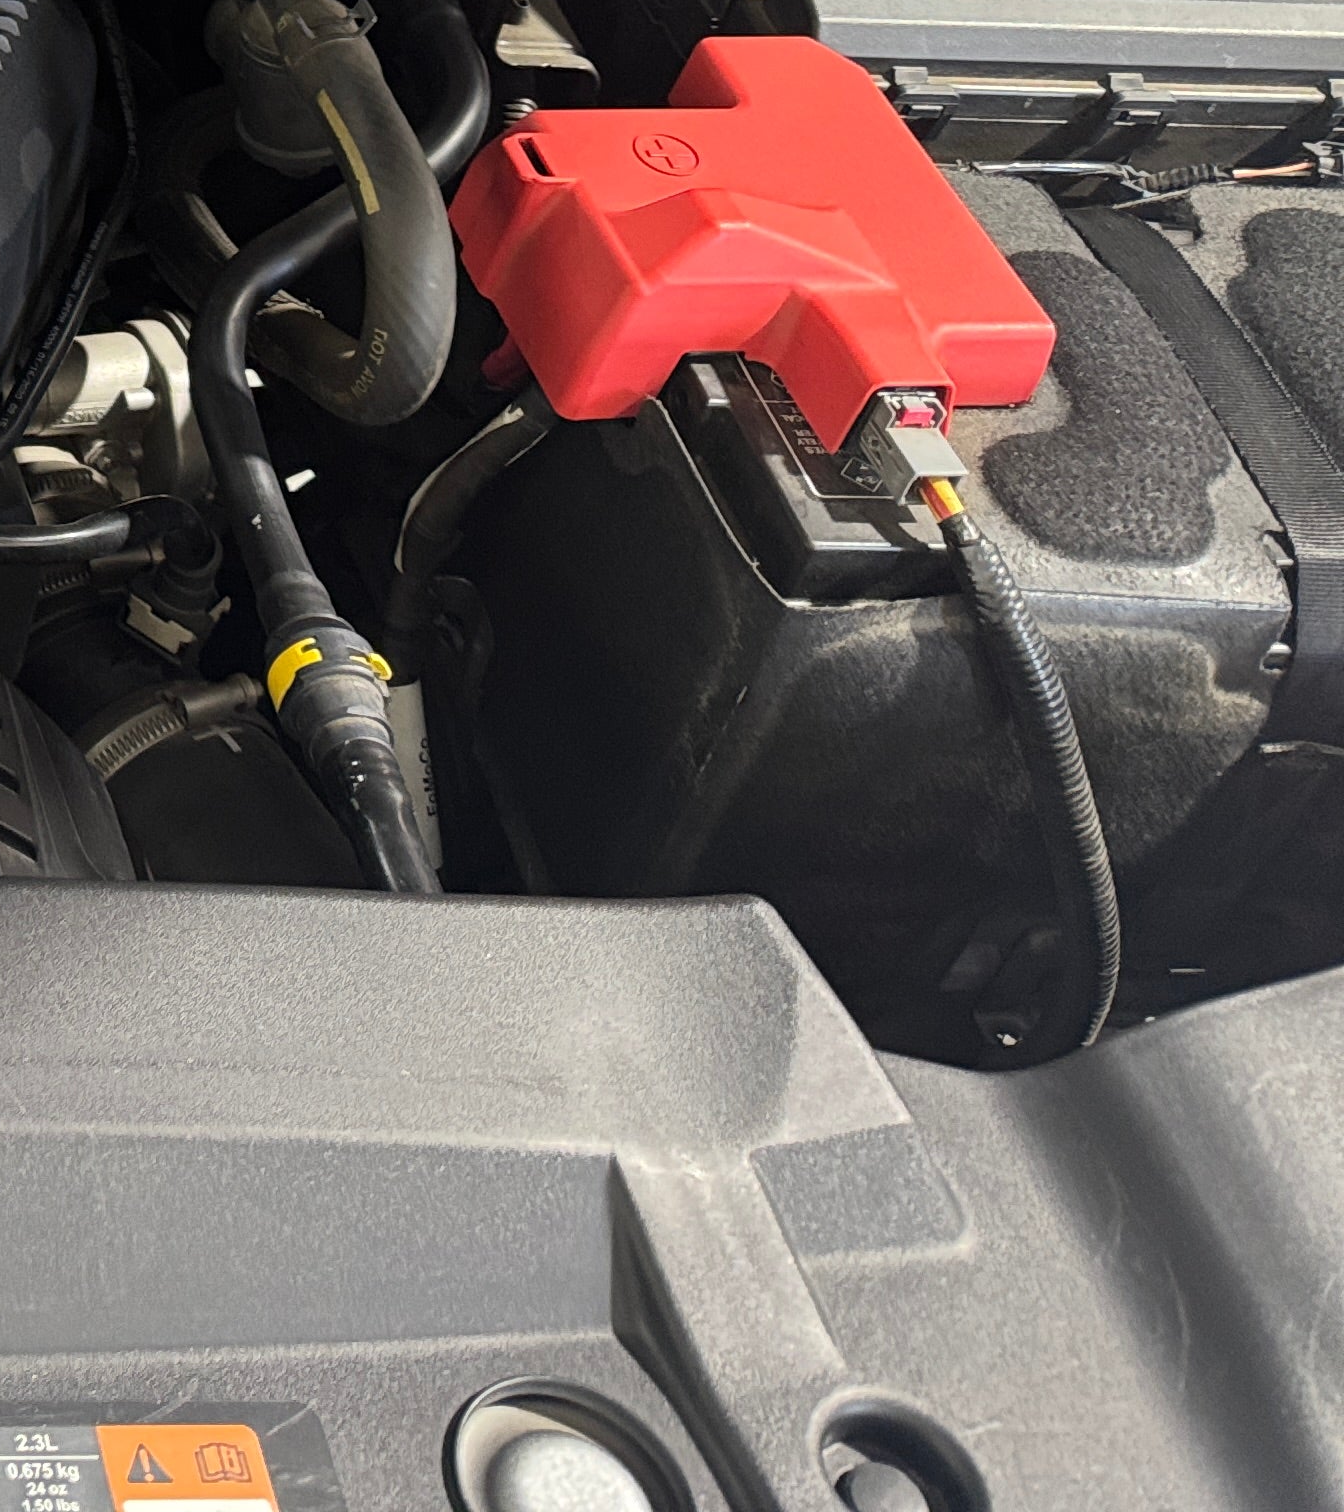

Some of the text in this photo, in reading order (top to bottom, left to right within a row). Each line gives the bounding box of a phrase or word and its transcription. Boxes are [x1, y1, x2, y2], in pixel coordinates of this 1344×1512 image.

[13, 1433, 59, 1452] 2.3L
[5, 1461, 80, 1482] 0.675 kg
[25, 1481, 69, 1496] 24 oz
[55, 1498, 80, 1512] lbs
